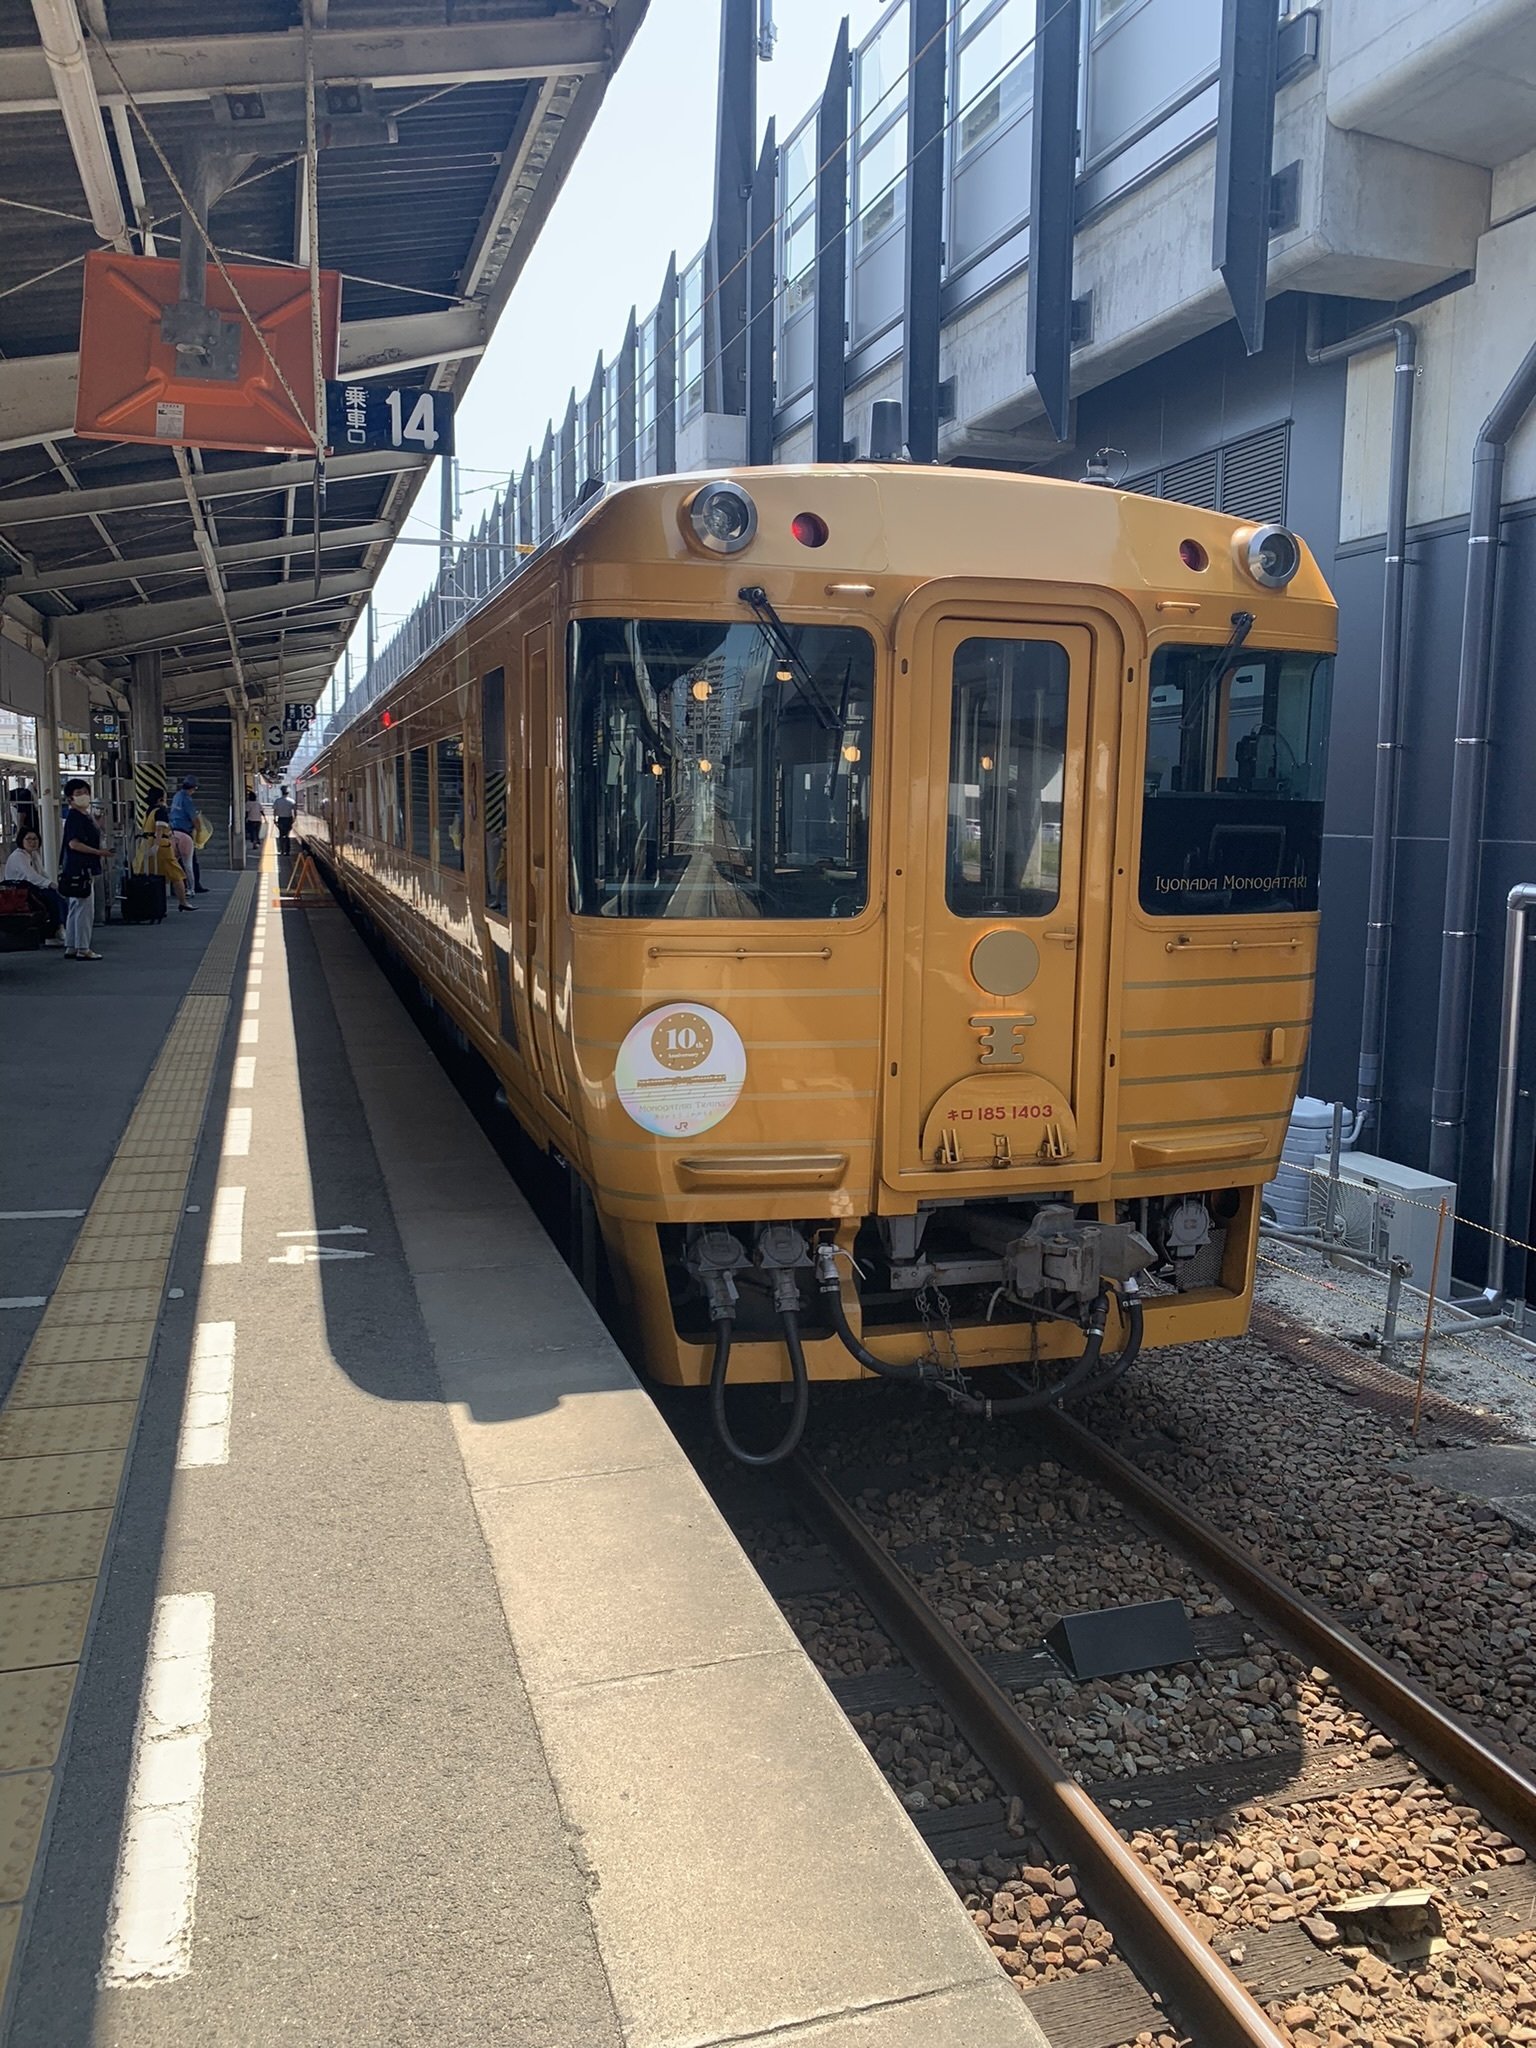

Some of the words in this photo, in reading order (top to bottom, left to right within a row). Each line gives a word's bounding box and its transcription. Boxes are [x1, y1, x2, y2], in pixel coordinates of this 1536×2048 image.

[345, 386, 367, 444] 乗車口
[385, 390, 439, 450] 14
[299, 704, 314, 719] 13
[296, 719, 307, 731] 12
[268, 725, 283, 746] 3
[947, 1109, 973, 1121] キロ
[978, 1106, 1006, 1121] 185
[1012, 1104, 1053, 1120] 1403
[674, 1121, 688, 1130] JR
